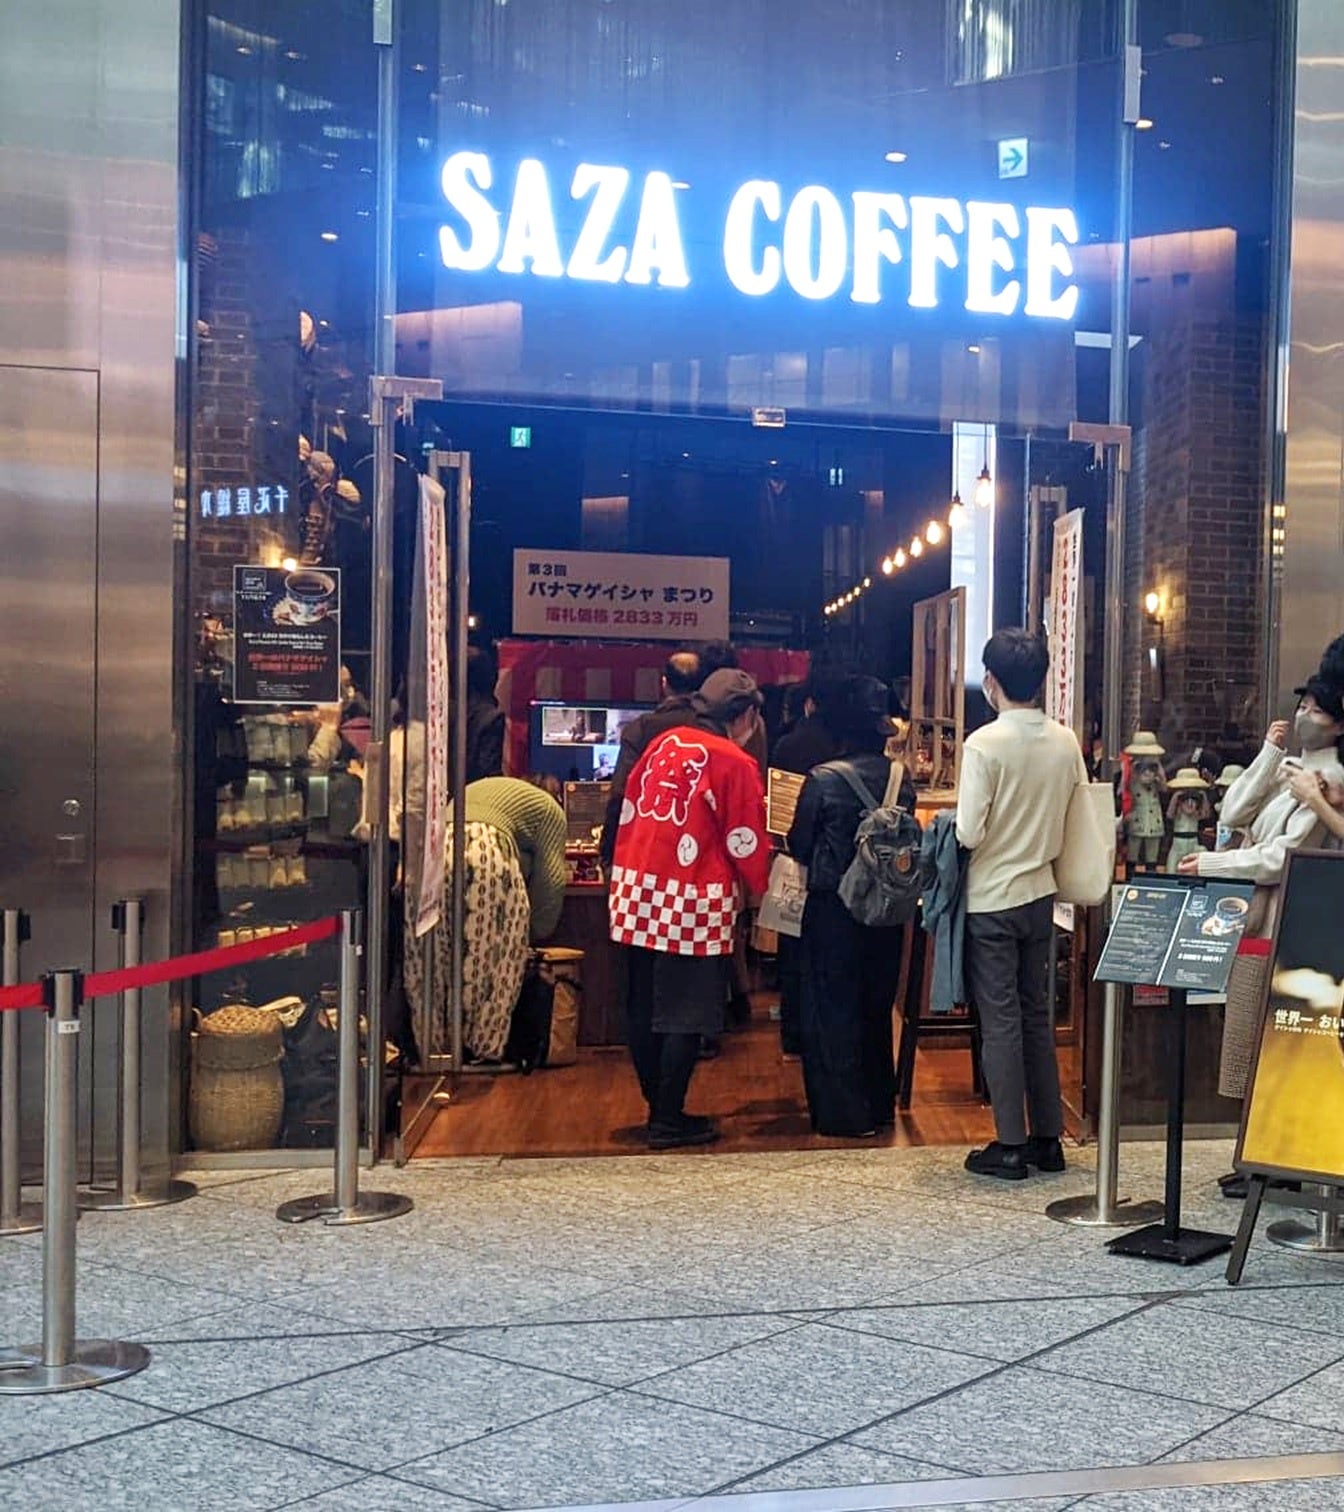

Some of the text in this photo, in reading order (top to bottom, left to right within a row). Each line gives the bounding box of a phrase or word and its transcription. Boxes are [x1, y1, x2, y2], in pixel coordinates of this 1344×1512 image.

[439, 151, 1080, 319] SAZA COFFEE
[528, 563, 567, 577] 第3回
[528, 581, 714, 603] パナマゲイシャ まつり
[613, 610, 663, 625] 2833
[668, 612, 698, 627] 万円
[1275, 1009, 1313, 1025] 世界一
